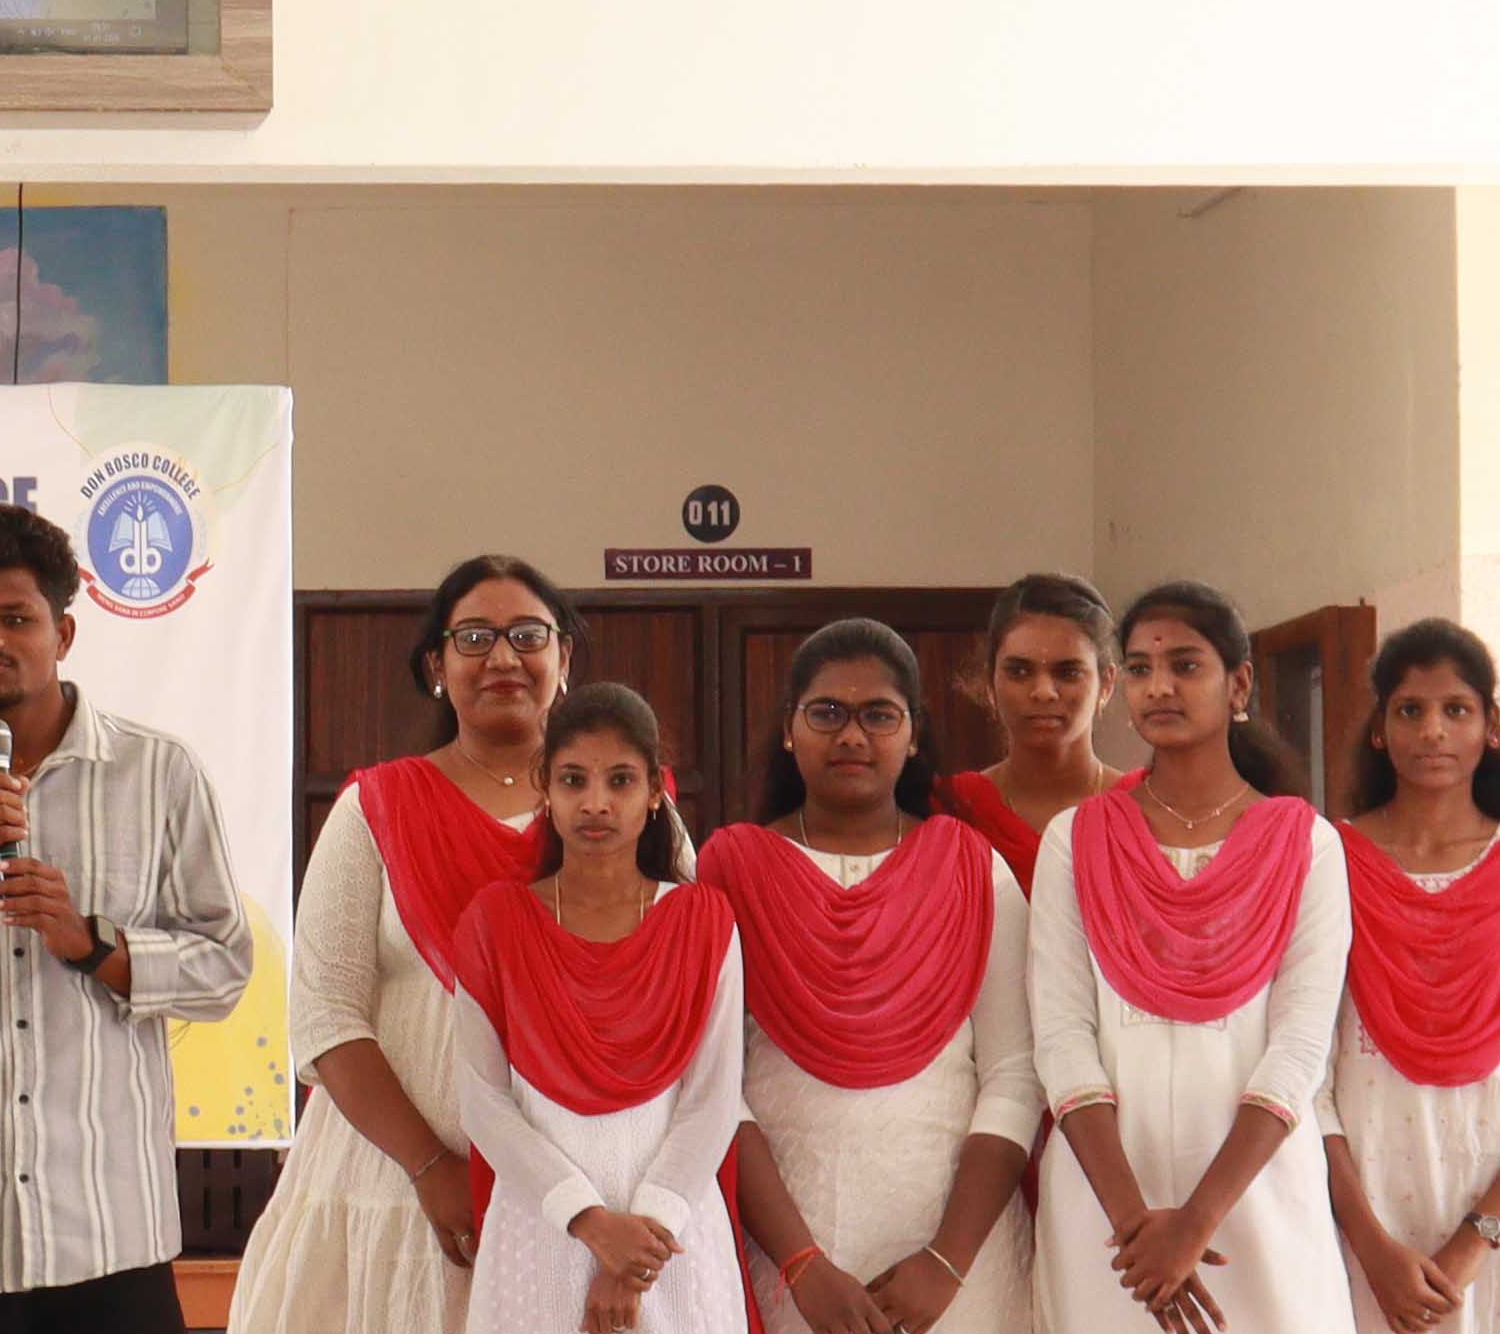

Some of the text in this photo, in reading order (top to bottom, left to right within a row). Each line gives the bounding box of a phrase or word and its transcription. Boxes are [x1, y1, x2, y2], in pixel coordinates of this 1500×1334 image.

[80, 452, 201, 501] DON BOSCO COLLEGE
[688, 500, 731, 526] 011
[615, 554, 691, 573] STORE
[698, 554, 768, 573] ROOM
[793, 555, 802, 572] 1
